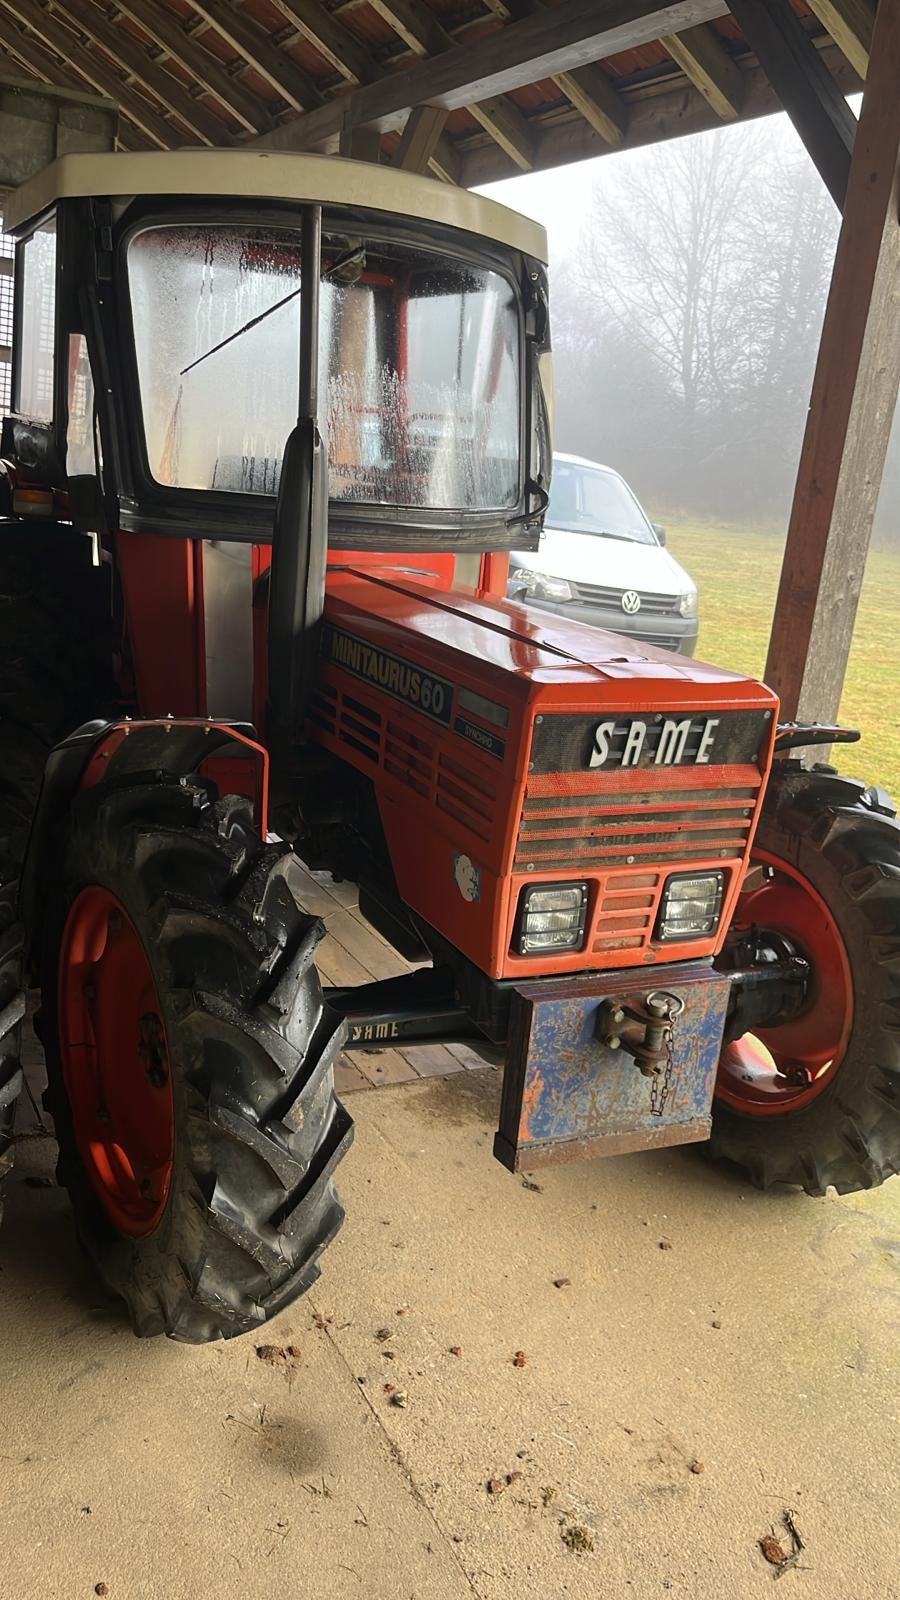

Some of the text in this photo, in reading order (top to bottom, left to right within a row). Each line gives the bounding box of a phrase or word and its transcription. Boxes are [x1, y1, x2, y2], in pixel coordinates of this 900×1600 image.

[621, 590, 641, 615] VW
[589, 719, 720, 768] SAME
[352, 1021, 399, 1040] SAME
